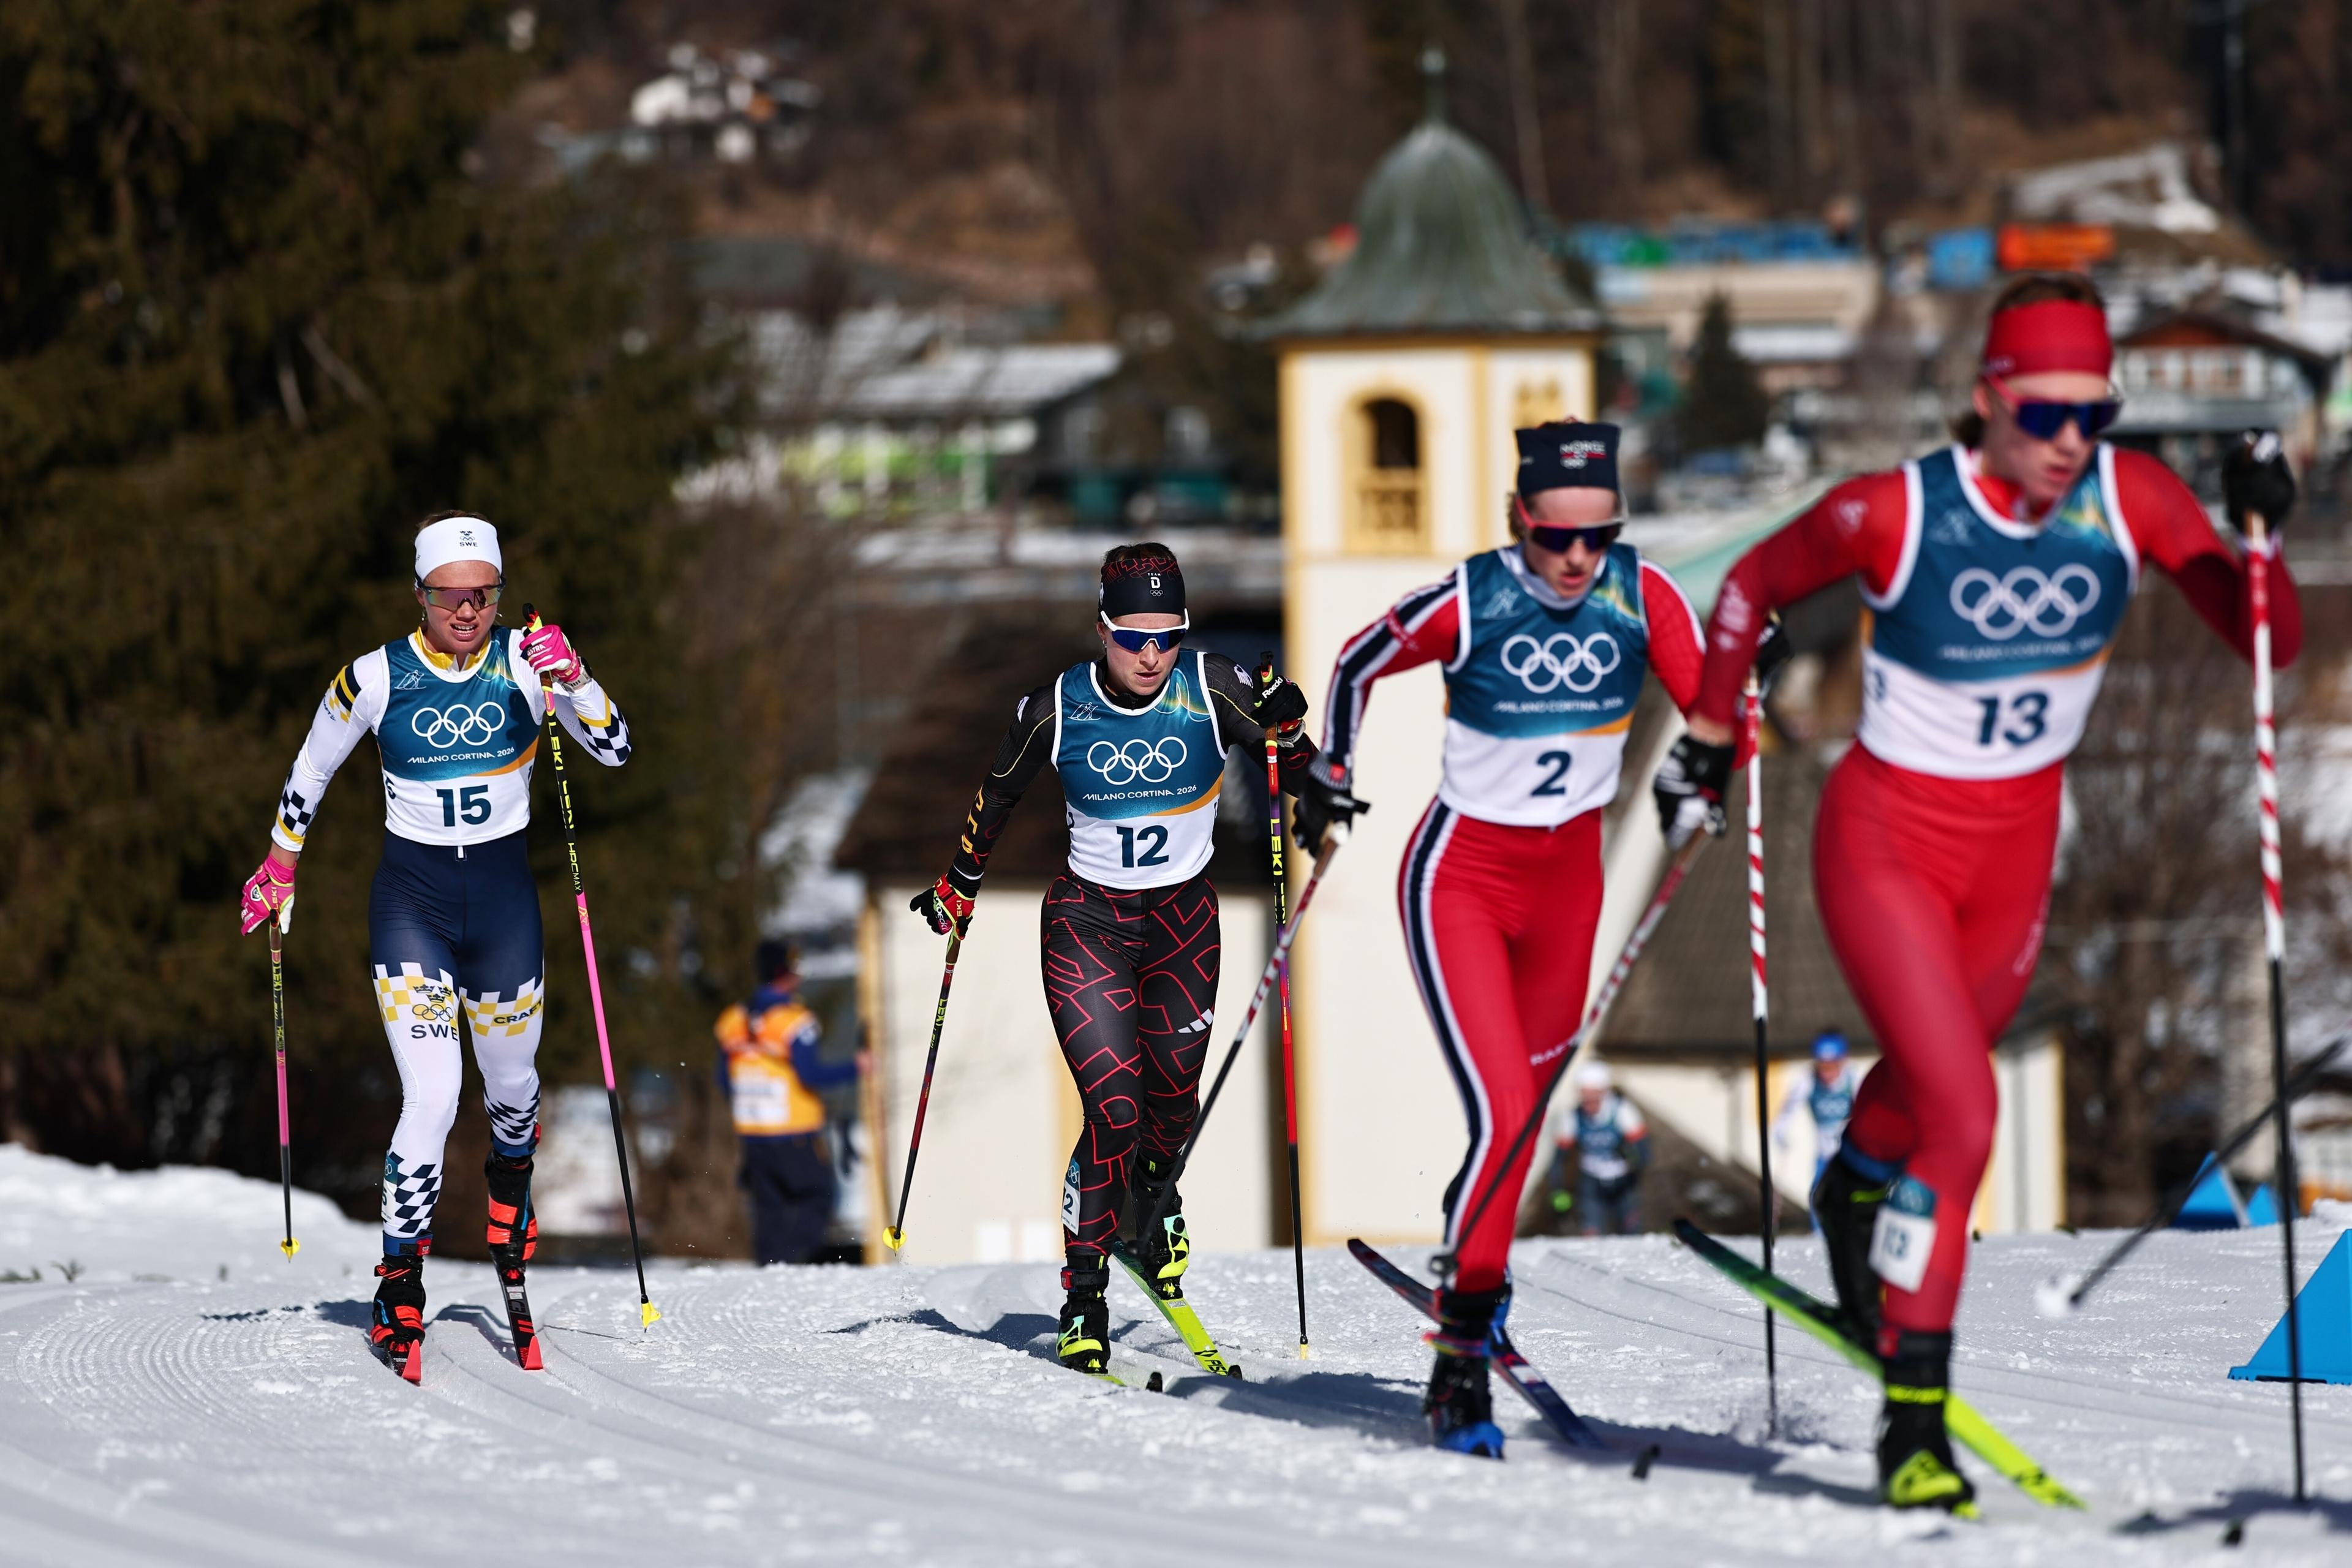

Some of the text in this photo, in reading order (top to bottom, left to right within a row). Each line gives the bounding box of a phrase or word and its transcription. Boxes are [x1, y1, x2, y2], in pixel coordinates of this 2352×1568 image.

[1150, 576, 1161, 589] D
[527, 644, 546, 656] ESTRA
[1975, 690, 2048, 748] 13
[407, 747, 514, 764] MILANO CORTINA 2026
[548, 722, 564, 771] LEKI
[1082, 785, 1197, 801] MILANO CORTINA 2026
[1530, 750, 1571, 796] 2
[436, 784, 491, 827] 15
[1116, 824, 1169, 868] 12
[1270, 818, 1283, 875] LEKI
[411, 1023, 458, 1041] SWE
